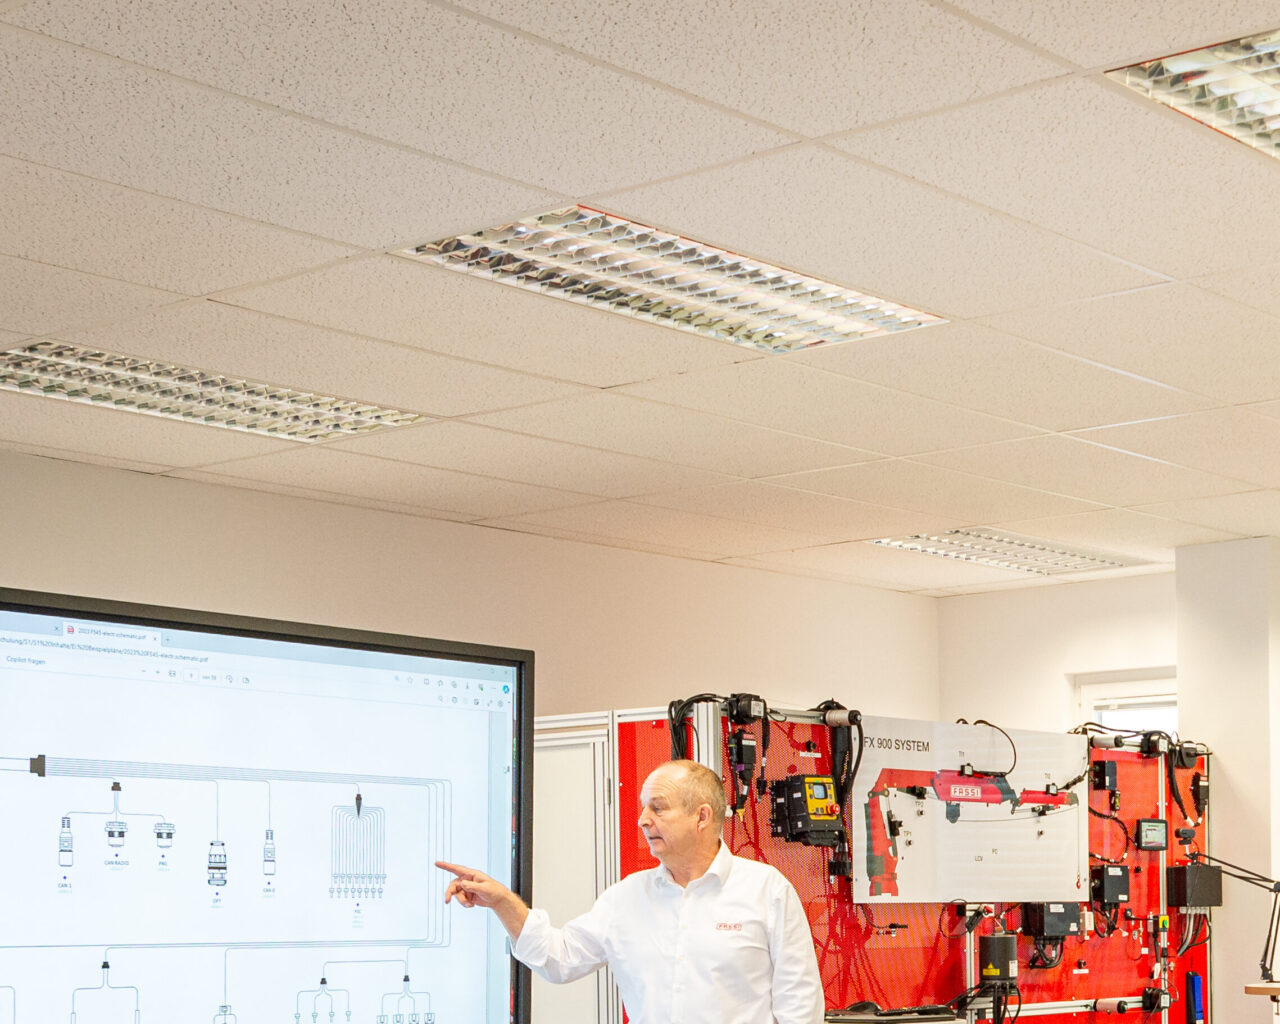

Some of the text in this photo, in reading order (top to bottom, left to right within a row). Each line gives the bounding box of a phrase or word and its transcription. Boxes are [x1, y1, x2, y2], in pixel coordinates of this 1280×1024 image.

[863, 736, 930, 753] FX 900 SYSTEM
[952, 786, 980, 797] FASSI
